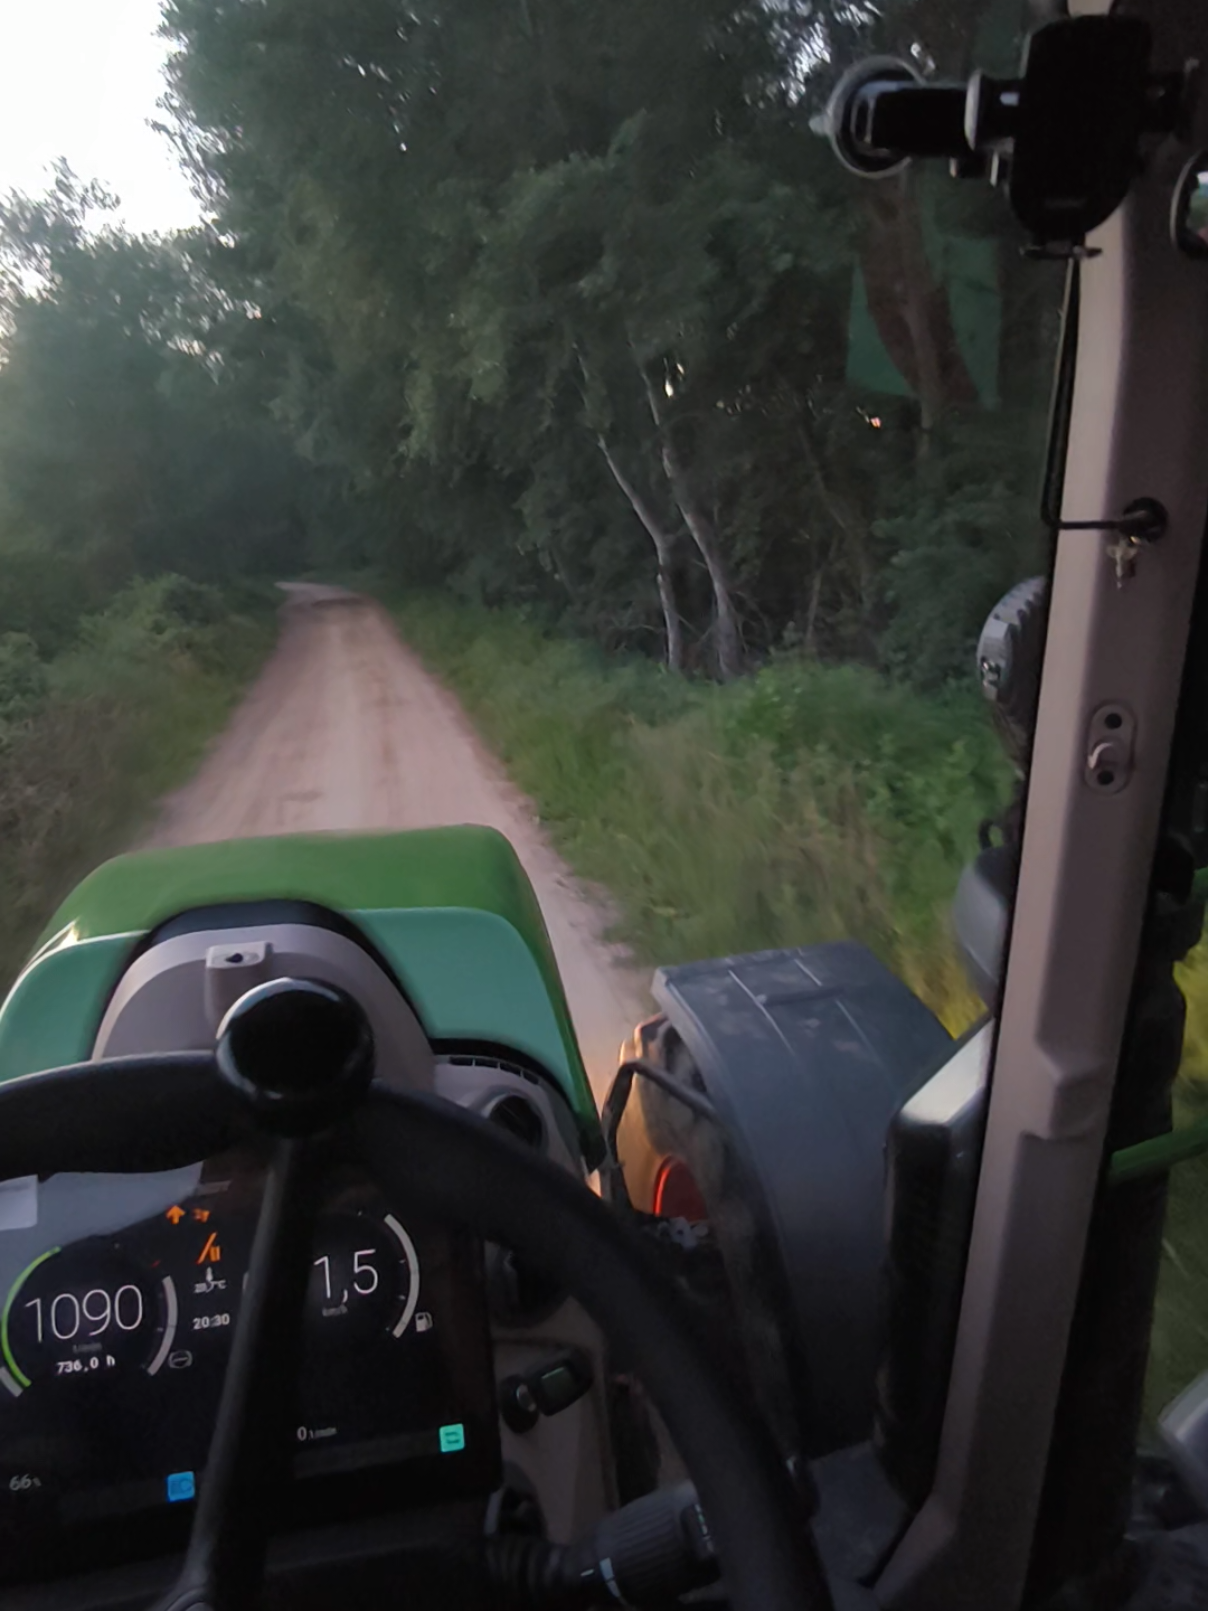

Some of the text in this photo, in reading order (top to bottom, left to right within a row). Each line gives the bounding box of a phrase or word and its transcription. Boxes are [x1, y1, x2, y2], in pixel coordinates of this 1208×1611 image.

[313, 1248, 379, 1304] 1,5
[23, 1284, 144, 1344] 1090
[192, 1312, 231, 1331] 20:30
[56, 1355, 99, 1375] 736,0
[296, 1425, 308, 1442] 0
